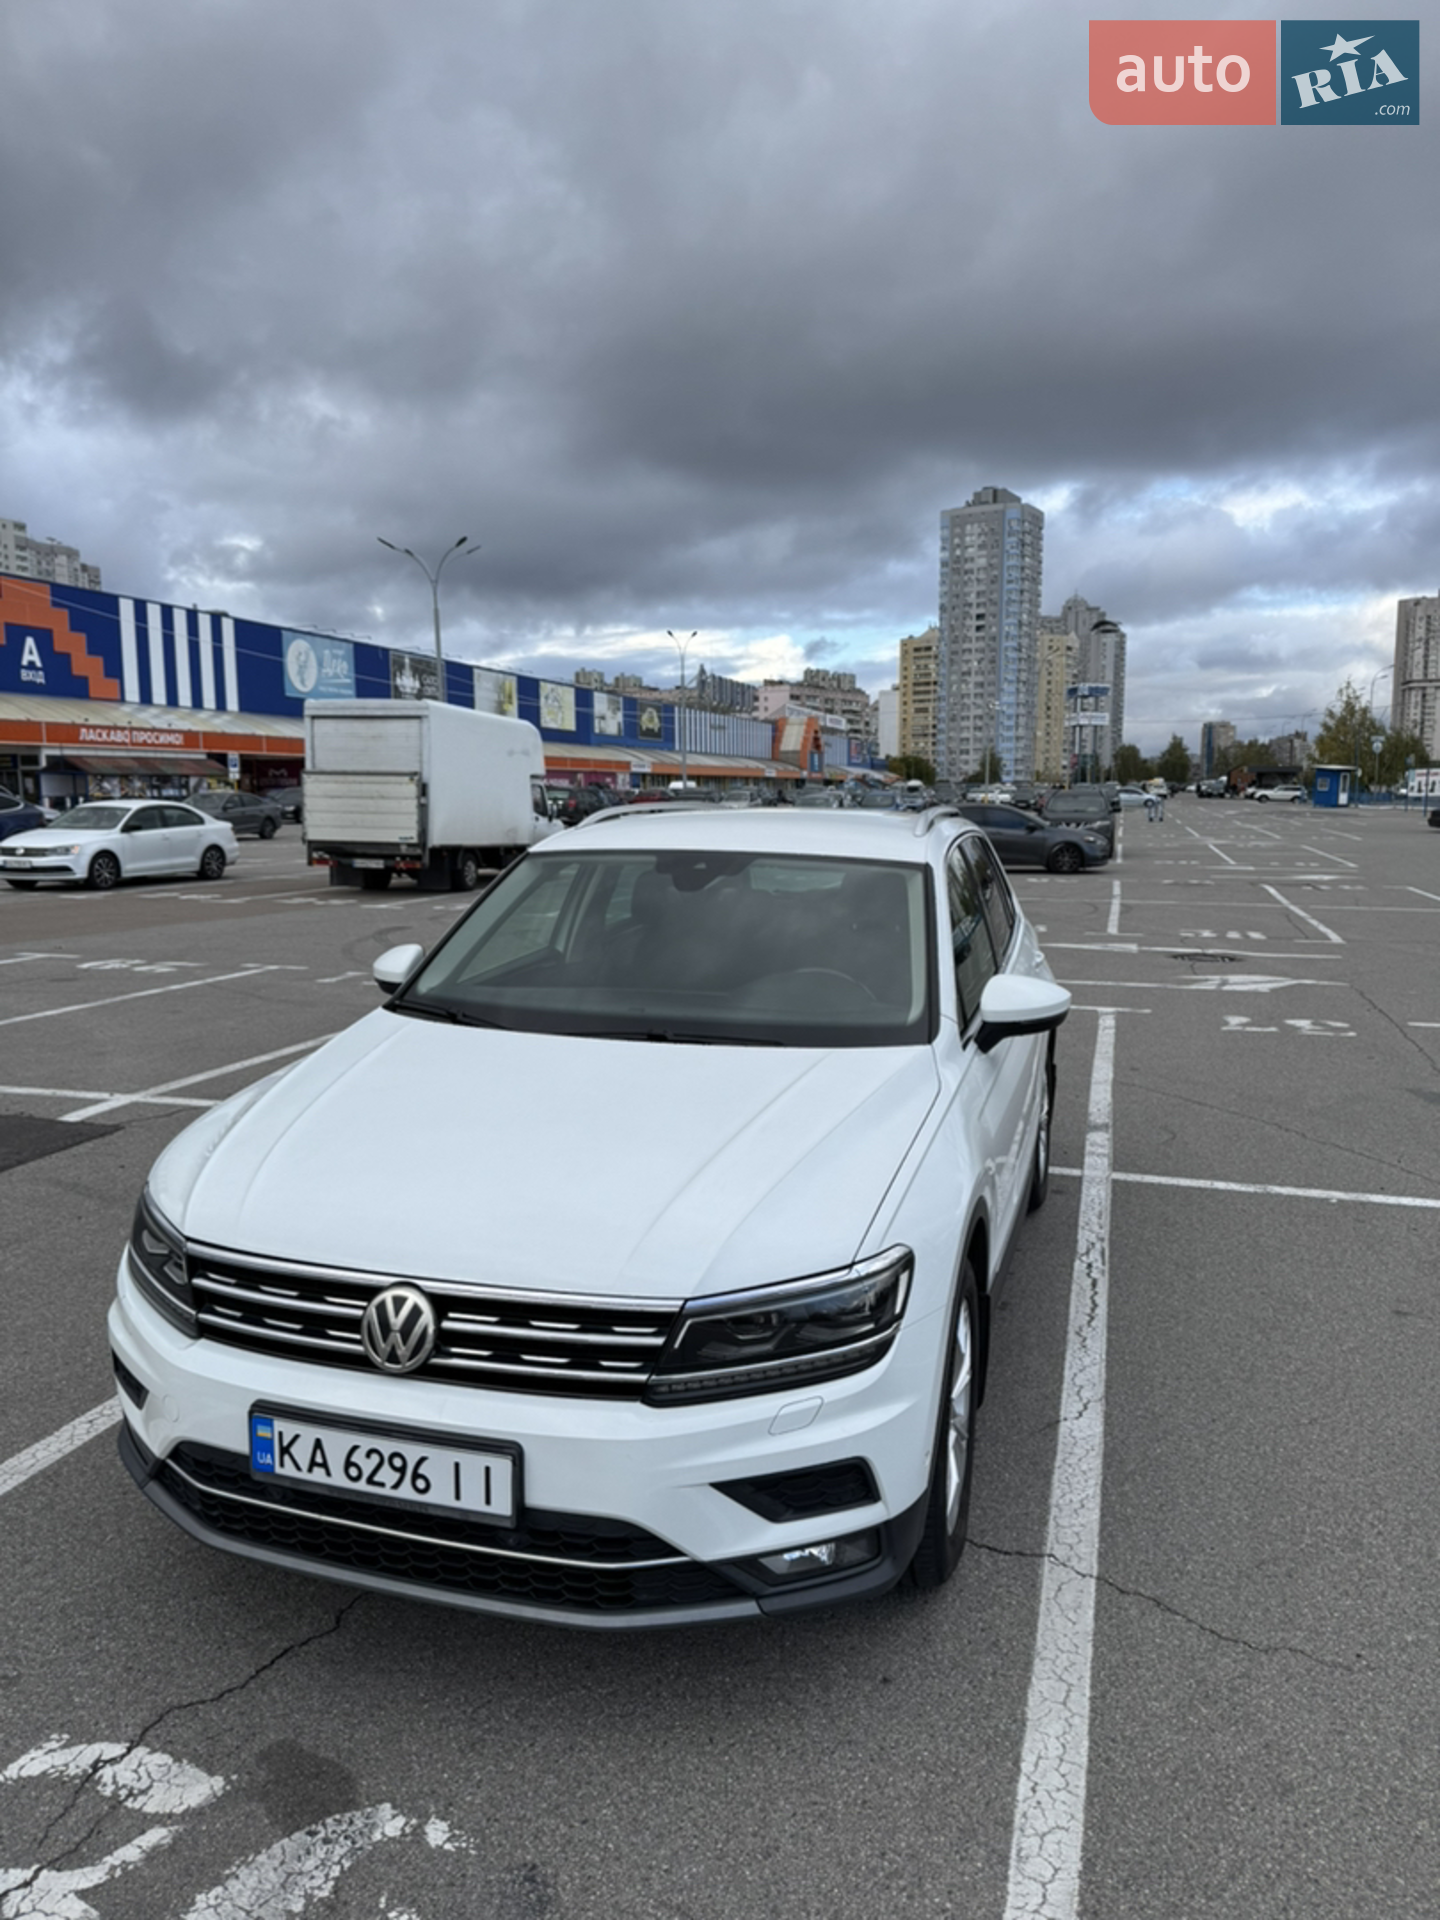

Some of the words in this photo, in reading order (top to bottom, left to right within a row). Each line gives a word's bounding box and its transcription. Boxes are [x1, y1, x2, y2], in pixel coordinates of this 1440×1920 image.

[20, 668, 46, 685] ВХІД
[79, 728, 129, 743] ЛАСКАВО
[256, 1451, 273, 1466] UA
[277, 1430, 332, 1478] KA
[343, 1445, 431, 1496] 6296
